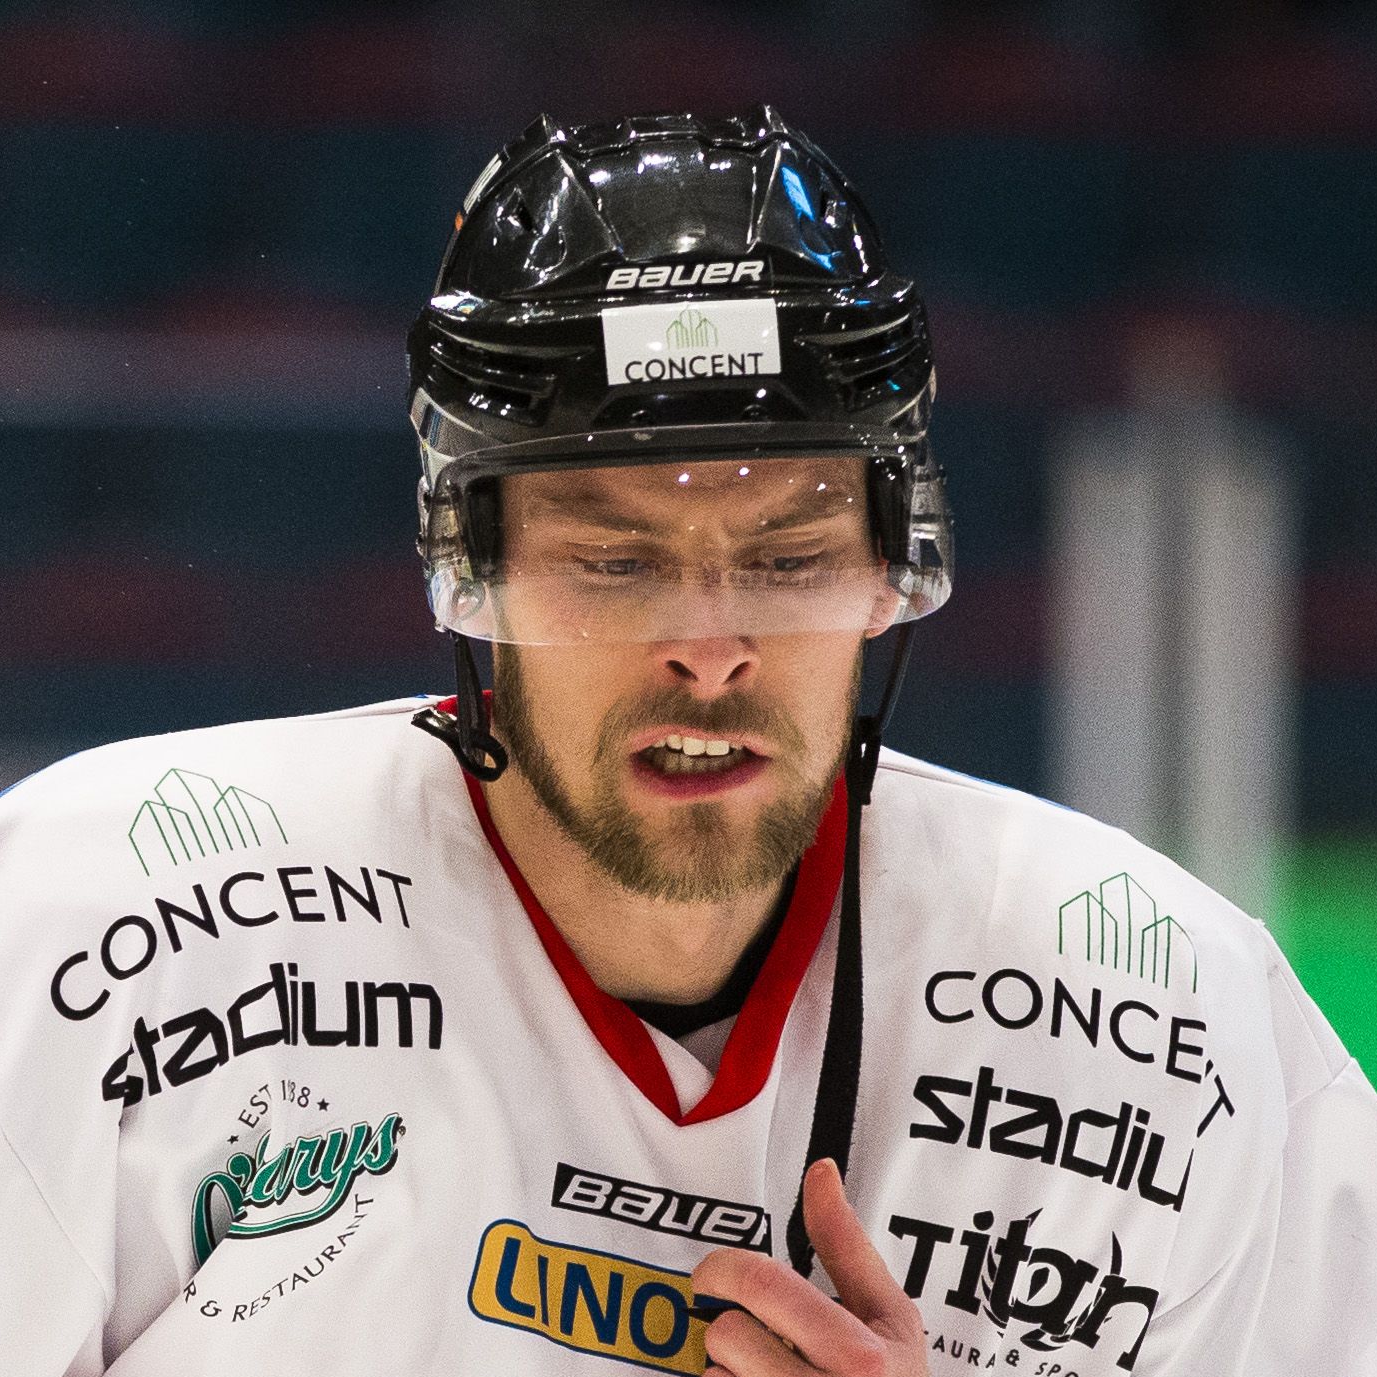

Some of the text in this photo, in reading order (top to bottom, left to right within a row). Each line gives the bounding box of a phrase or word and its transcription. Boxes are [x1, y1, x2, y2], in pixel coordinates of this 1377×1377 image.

[624, 351, 765, 383] CONCENT
[50, 865, 413, 1022] CONCENT
[101, 961, 444, 1107] stadium
[924, 967, 1235, 1139] CONCET
[238, 1083, 272, 1128] EST
[909, 1066, 1196, 1213] stadiu
[495, 1237, 691, 1359] LINO
[1005, 1349, 1020, 1367] &
